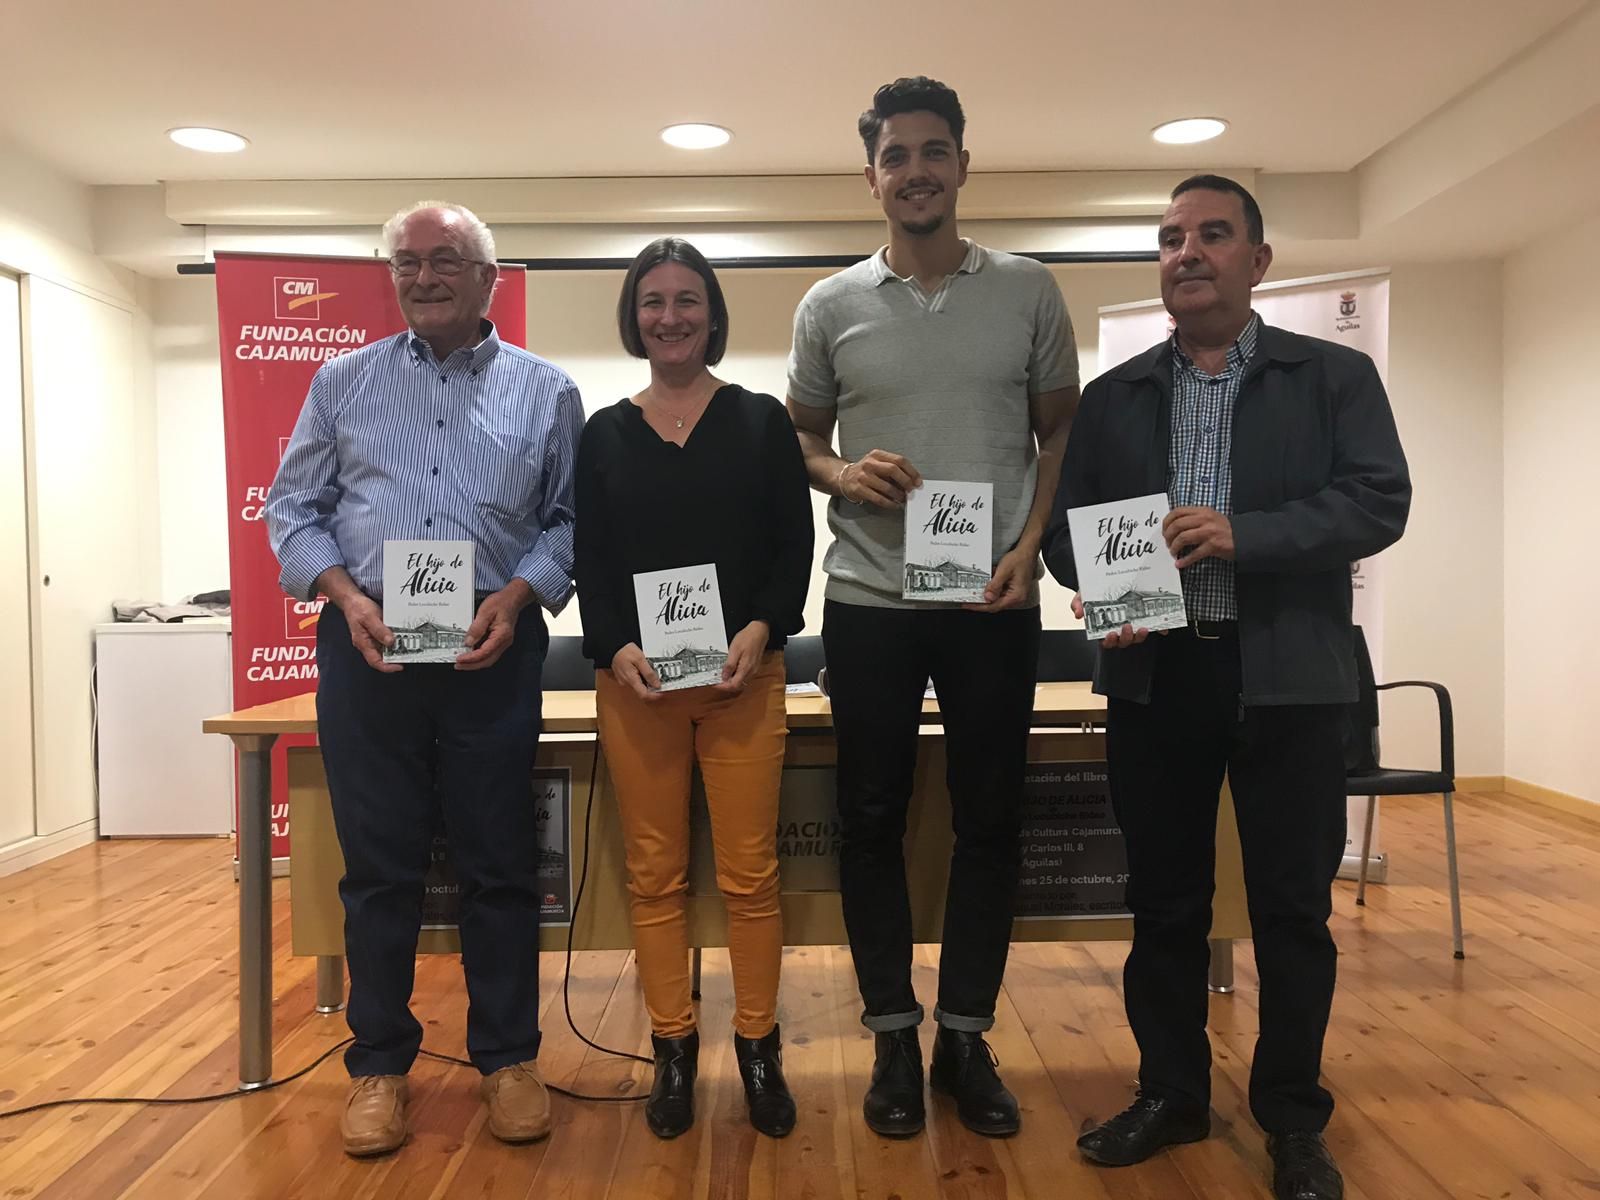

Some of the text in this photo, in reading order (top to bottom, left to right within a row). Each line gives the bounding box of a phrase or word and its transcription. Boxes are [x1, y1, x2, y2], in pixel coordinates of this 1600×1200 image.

[282, 280, 315, 295] CM
[240, 325, 367, 344] FUNDACIÓN
[235, 344, 361, 362] CAJAMUR
[930, 493, 984, 515] El hijo de
[922, 508, 978, 536] Alicia
[1098, 511, 1159, 538] El hijo de
[1095, 532, 1157, 566] Alicia
[407, 552, 464, 575] El hijo de
[400, 567, 458, 597] Alicia
[658, 578, 711, 601] El hijo de
[293, 601, 325, 615] CM
[655, 595, 709, 626] Alicia
[1064, 771, 1080, 782] del
[1083, 771, 1108, 782] libro
[1032, 828, 1068, 837] Cultura
[1030, 843, 1062, 853] Carlos
[1077, 842, 1085, 851] 8
[1039, 874, 1053, 885] 25
[1055, 874, 1069, 885] de
[1070, 873, 1115, 885] octubre,
